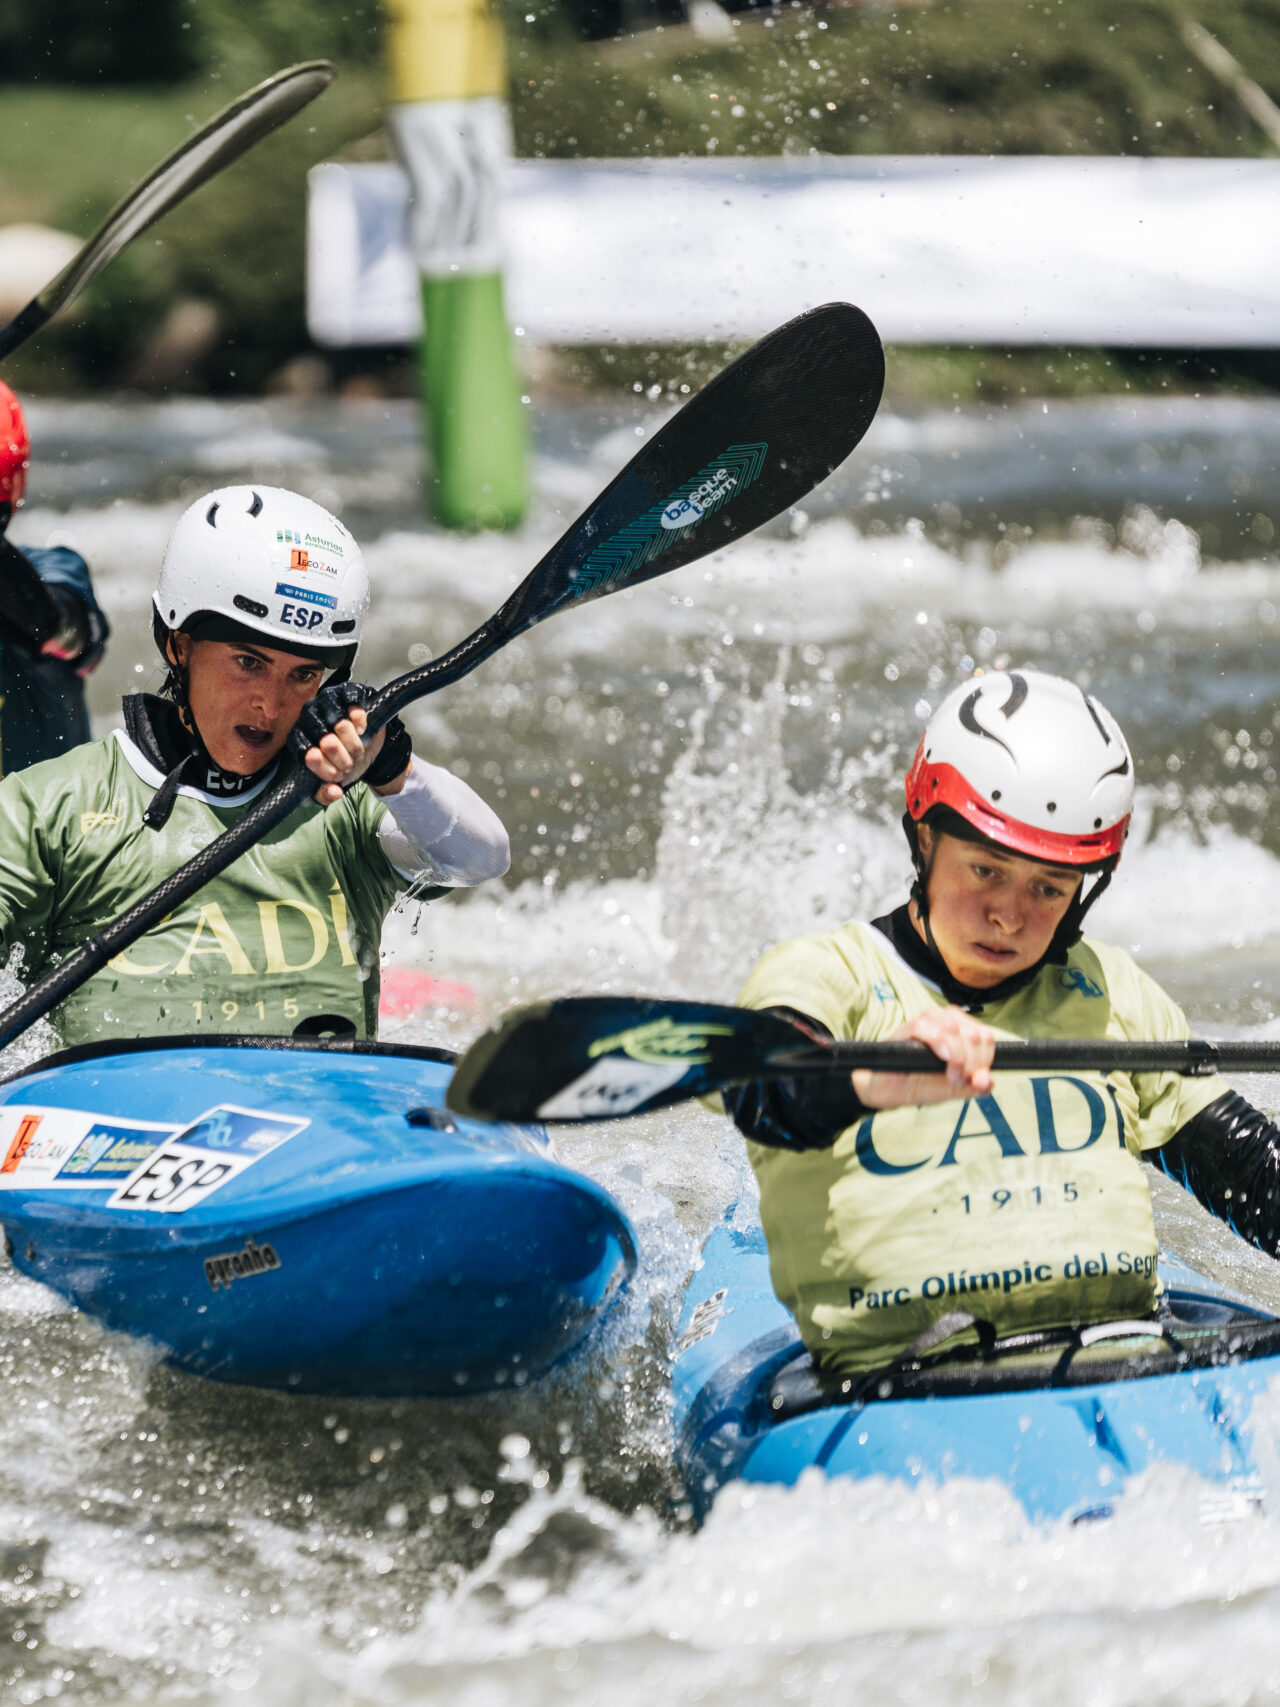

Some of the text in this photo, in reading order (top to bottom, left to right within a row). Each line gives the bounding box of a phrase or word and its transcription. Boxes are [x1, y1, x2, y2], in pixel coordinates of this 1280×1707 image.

[664, 468, 728, 521] basque
[692, 477, 738, 516] team
[304, 532, 343, 554] Asturias
[280, 602, 324, 631] ESP
[192, 998, 300, 1022] 1915
[120, 1153, 233, 1205] ESP
[960, 1181, 1079, 1215] 1915
[849, 1285, 912, 1311] Parc
[921, 1260, 1053, 1301] Olímpic
[1063, 1252, 1108, 1280] del
